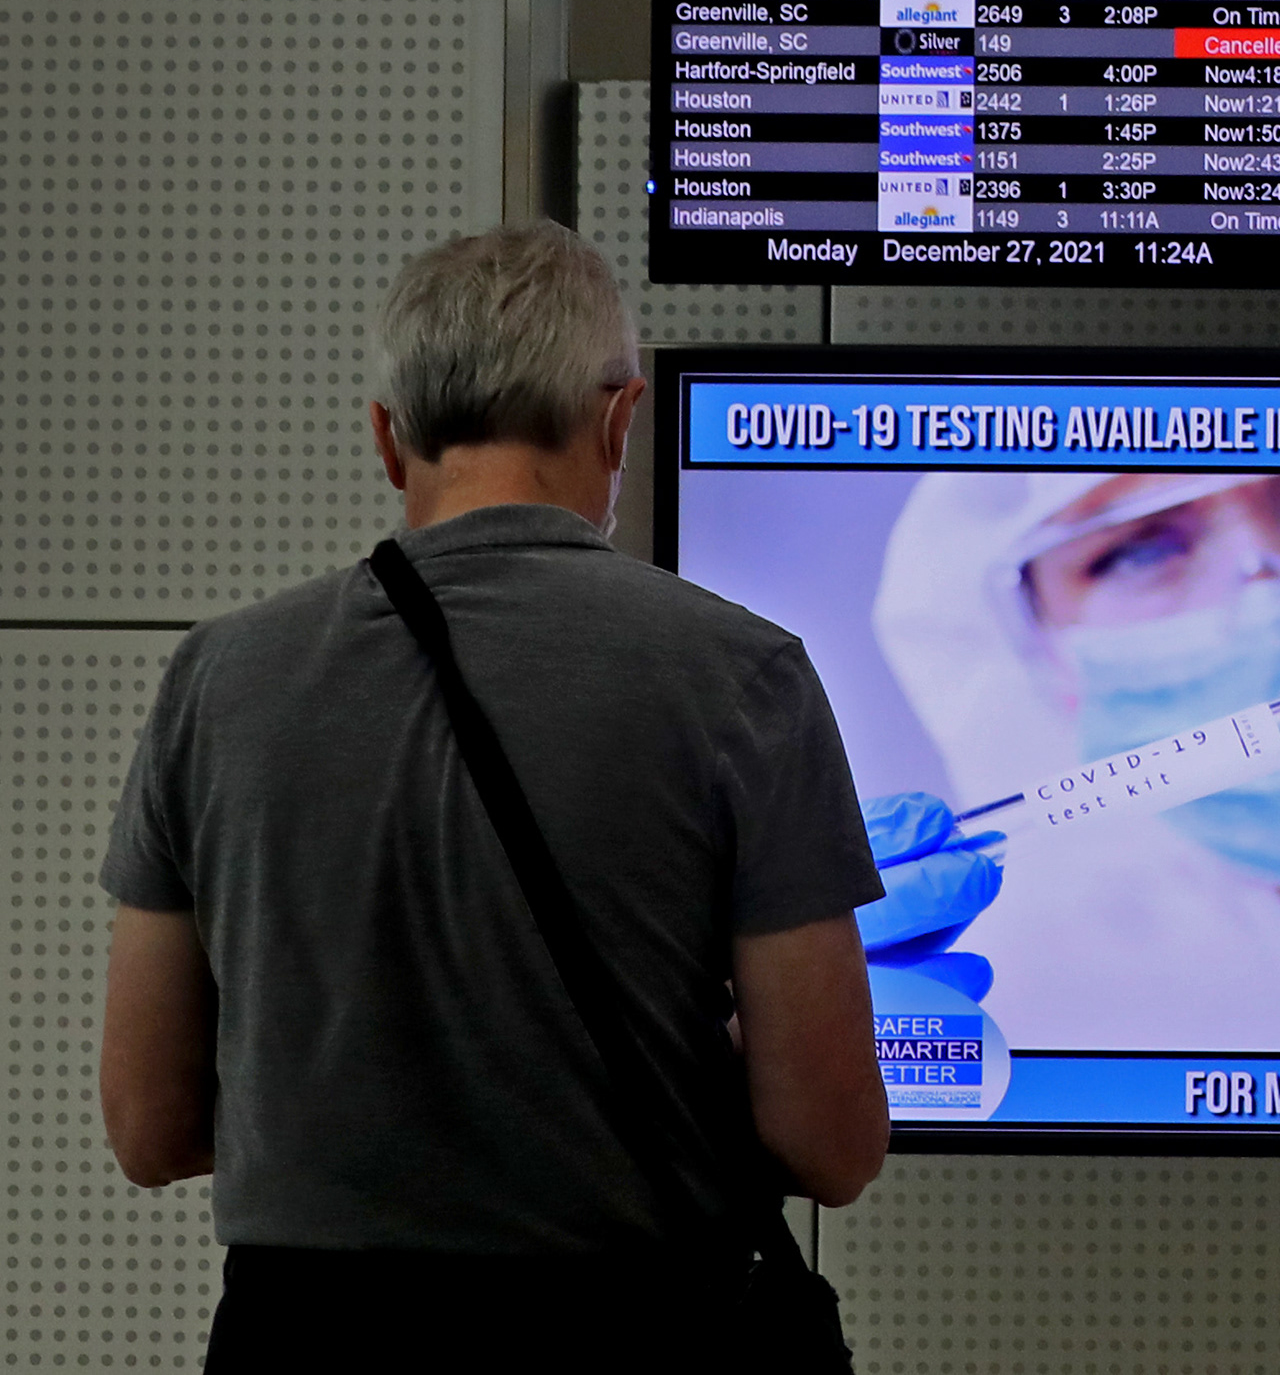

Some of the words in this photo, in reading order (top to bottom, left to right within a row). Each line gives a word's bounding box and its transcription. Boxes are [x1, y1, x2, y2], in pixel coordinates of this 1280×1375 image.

[674, 32, 772, 54] Greenville,
[778, 33, 807, 50] SC
[920, 33, 960, 49] Silver
[980, 34, 1010, 52] 149
[768, 239, 857, 265] Monday
[884, 239, 1000, 261] December
[1007, 241, 1041, 265] 27,
[1050, 241, 1103, 263] 2021
[1135, 242, 1213, 264] 11:24A
[727, 402, 898, 452] COVID-19
[906, 402, 1056, 453] TESTING
[1064, 403, 1258, 454] AVAILABLE
[1048, 796, 1106, 825] test
[1126, 772, 1170, 798] kit
[880, 1065, 956, 1083] ETTER
[1184, 1071, 1258, 1117] FOR
